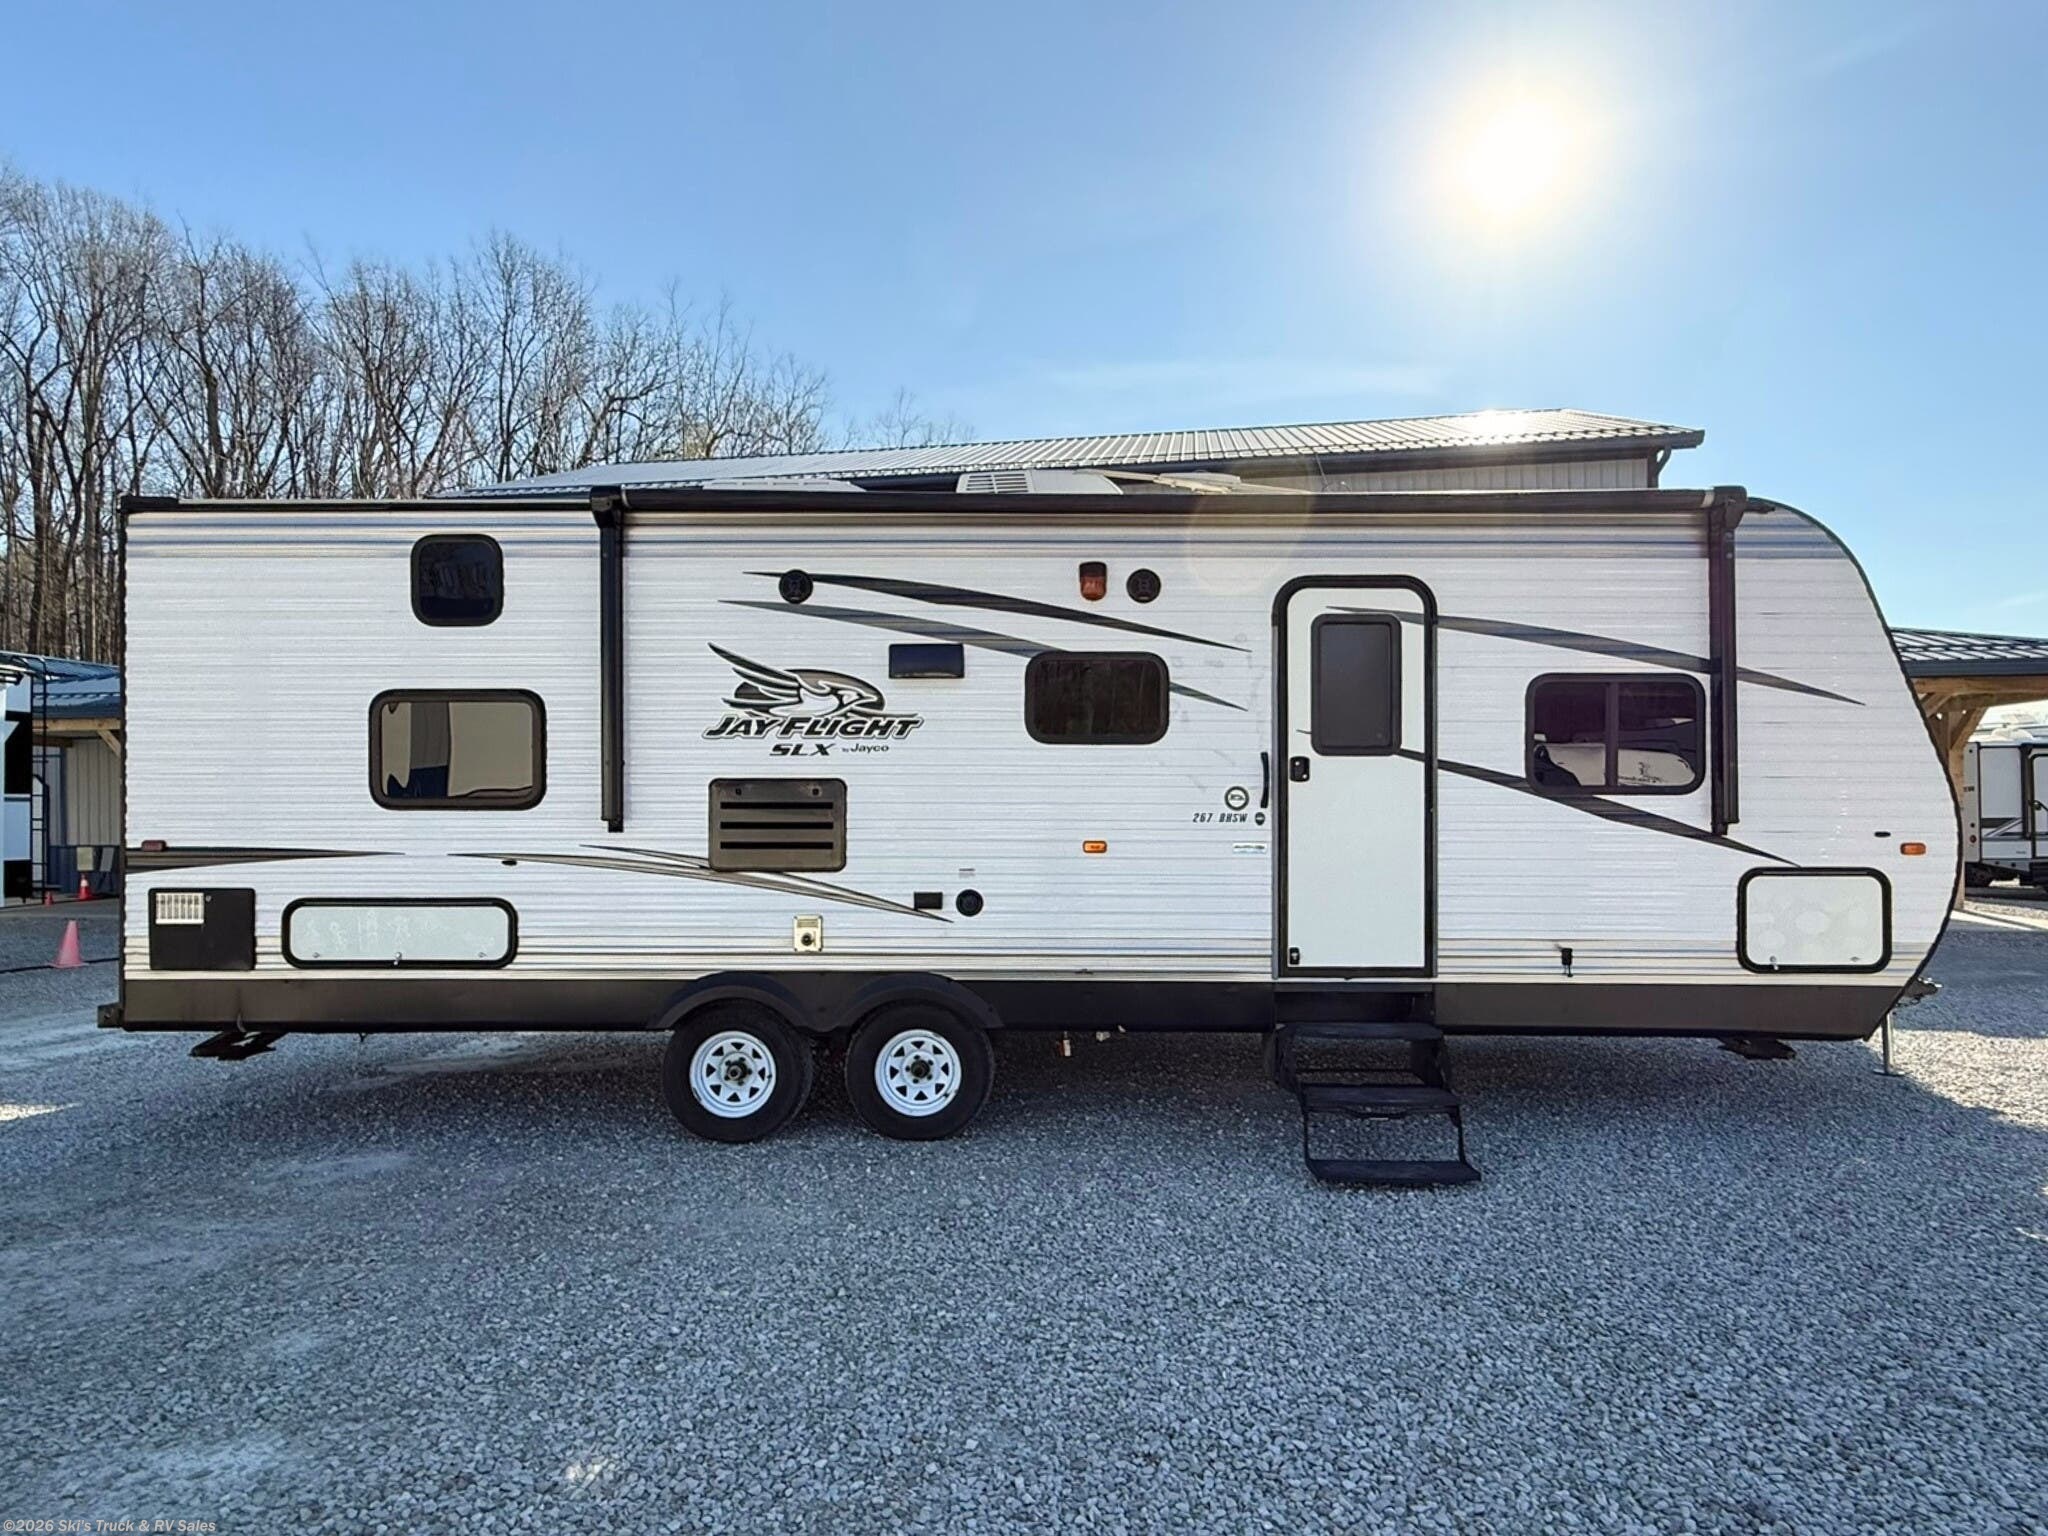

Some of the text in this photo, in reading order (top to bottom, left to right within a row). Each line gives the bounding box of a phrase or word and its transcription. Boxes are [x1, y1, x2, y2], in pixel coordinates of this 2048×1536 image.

[704, 716, 923, 738] JAY FLIGHT
[769, 743, 836, 756] SLX
[850, 743, 890, 754] Jayco
[1192, 812, 1214, 823] 267
